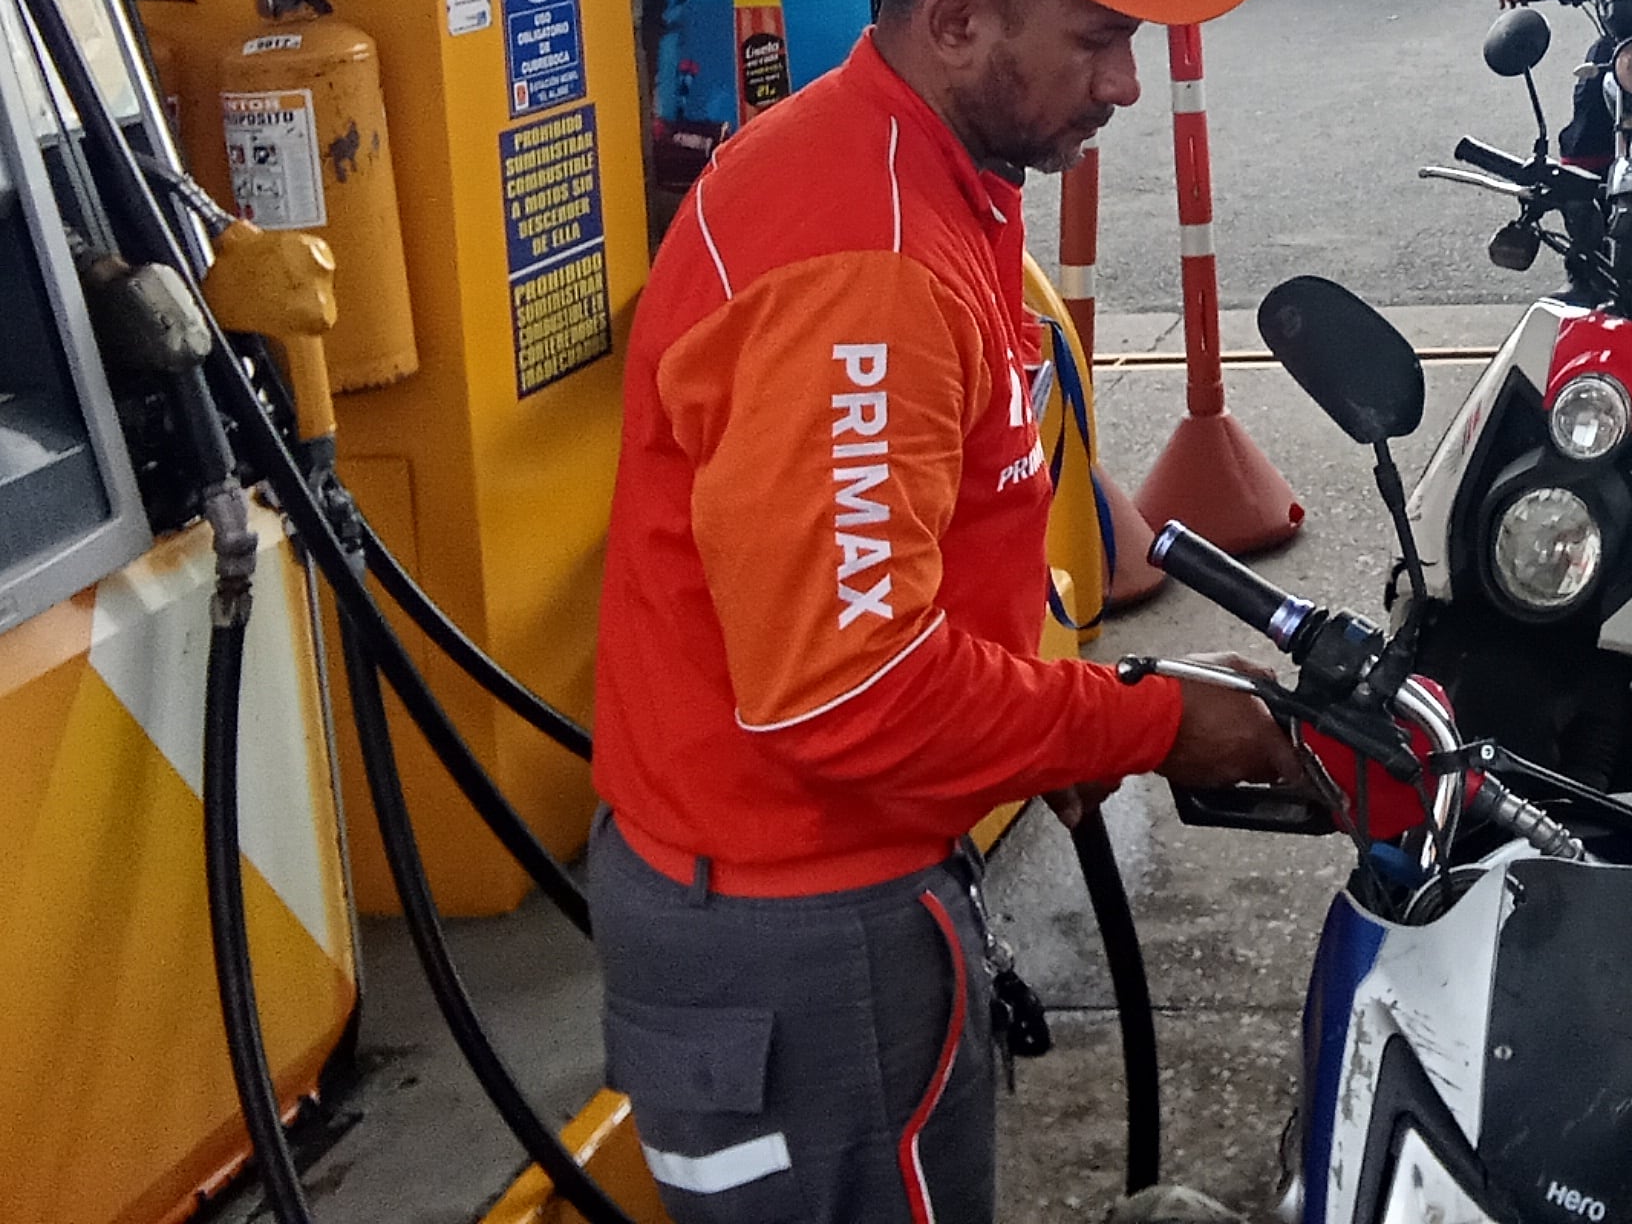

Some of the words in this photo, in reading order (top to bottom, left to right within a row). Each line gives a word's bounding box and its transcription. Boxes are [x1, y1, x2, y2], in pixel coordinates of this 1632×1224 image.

[505, 131, 594, 177] SUMINISTRAR
[514, 113, 583, 151] PROHIBIDO
[507, 151, 594, 199] COMBUSTIBLE
[525, 182, 569, 215] MOTOS
[571, 173, 594, 197] SIN
[518, 197, 591, 240] DESCENDER
[532, 233, 548, 256] DE
[552, 221, 581, 248] ELLA
[514, 252, 603, 307] PROHIBIDO
[517, 271, 604, 328] SUMINISTRAR
[832, 343, 893, 630] PRIMAX
[997, 438, 1045, 492] PRIM
[1546, 1181, 1605, 1221] Hero
